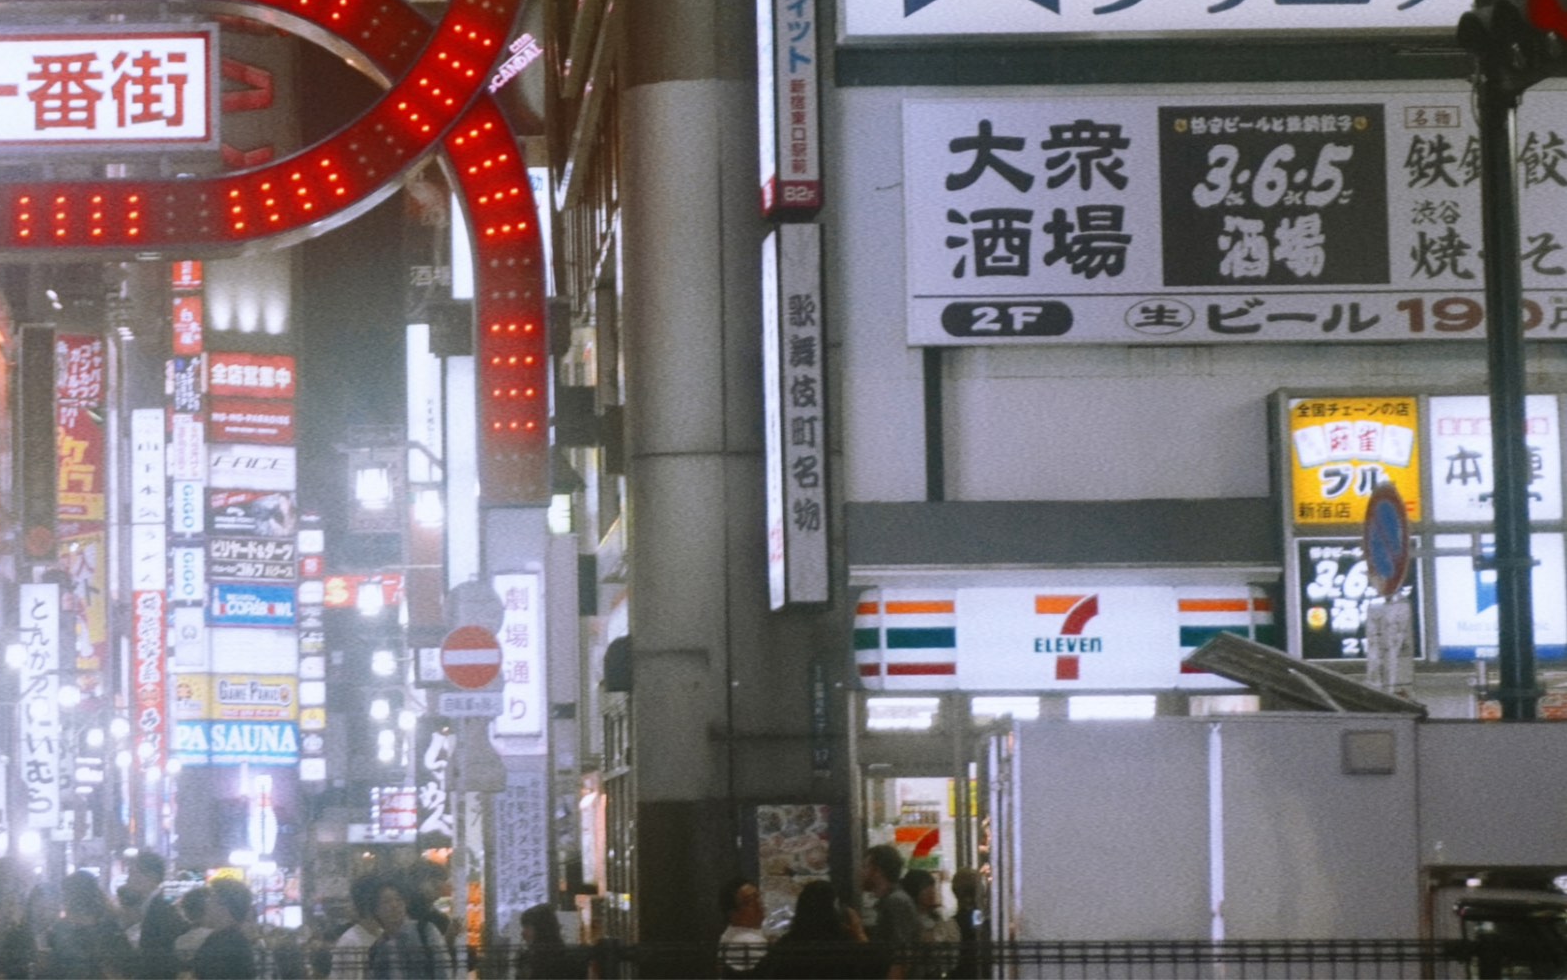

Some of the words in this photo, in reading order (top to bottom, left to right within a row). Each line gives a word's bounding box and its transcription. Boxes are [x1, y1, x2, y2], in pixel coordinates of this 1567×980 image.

[1412, 108, 1451, 126] 名物
[944, 119, 1132, 192] 大衆
[1410, 199, 1461, 225] 渋谷
[945, 204, 1133, 280] 酒場
[1217, 212, 1326, 278] 酒場
[1409, 226, 1567, 281] 焼そ
[970, 305, 1041, 332] 2F
[1206, 296, 1381, 335] ビール
[788, 293, 821, 532] 歌舞伎町名物
[1296, 402, 1410, 417] 全国チェーンの店
[1329, 423, 1378, 453] 麻雀
[1298, 502, 1351, 519] 新宿店
[504, 586, 530, 720] 劇場通り
[211, 724, 299, 752] SAUNA
